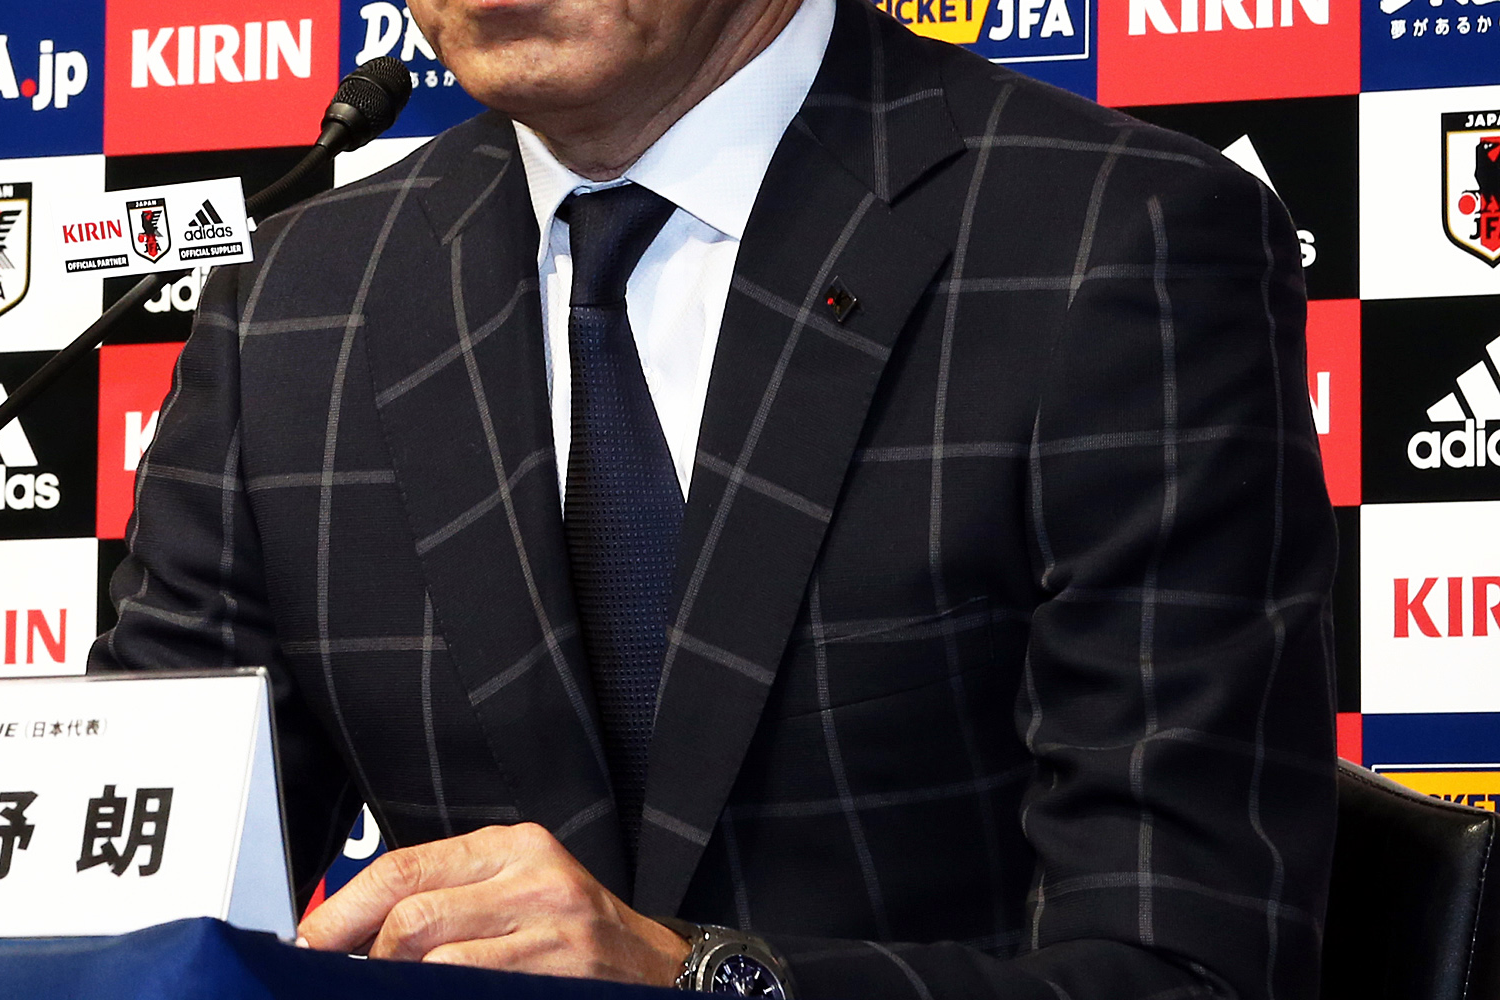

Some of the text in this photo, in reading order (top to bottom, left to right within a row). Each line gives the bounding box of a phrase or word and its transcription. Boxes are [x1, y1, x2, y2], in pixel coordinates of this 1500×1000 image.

[131, 19, 312, 88] KIRIN
[135, 200, 157, 208] JAPAN
[62, 219, 122, 243] KIRIN
[184, 226, 233, 241] adidas
[180, 244, 242, 259] OFFICIAL SUPPLIER
[67, 256, 127, 271] OFFICIAL PARTNER
[1393, 576, 1500, 638] KIR
[76, 784, 174, 877] 朗
